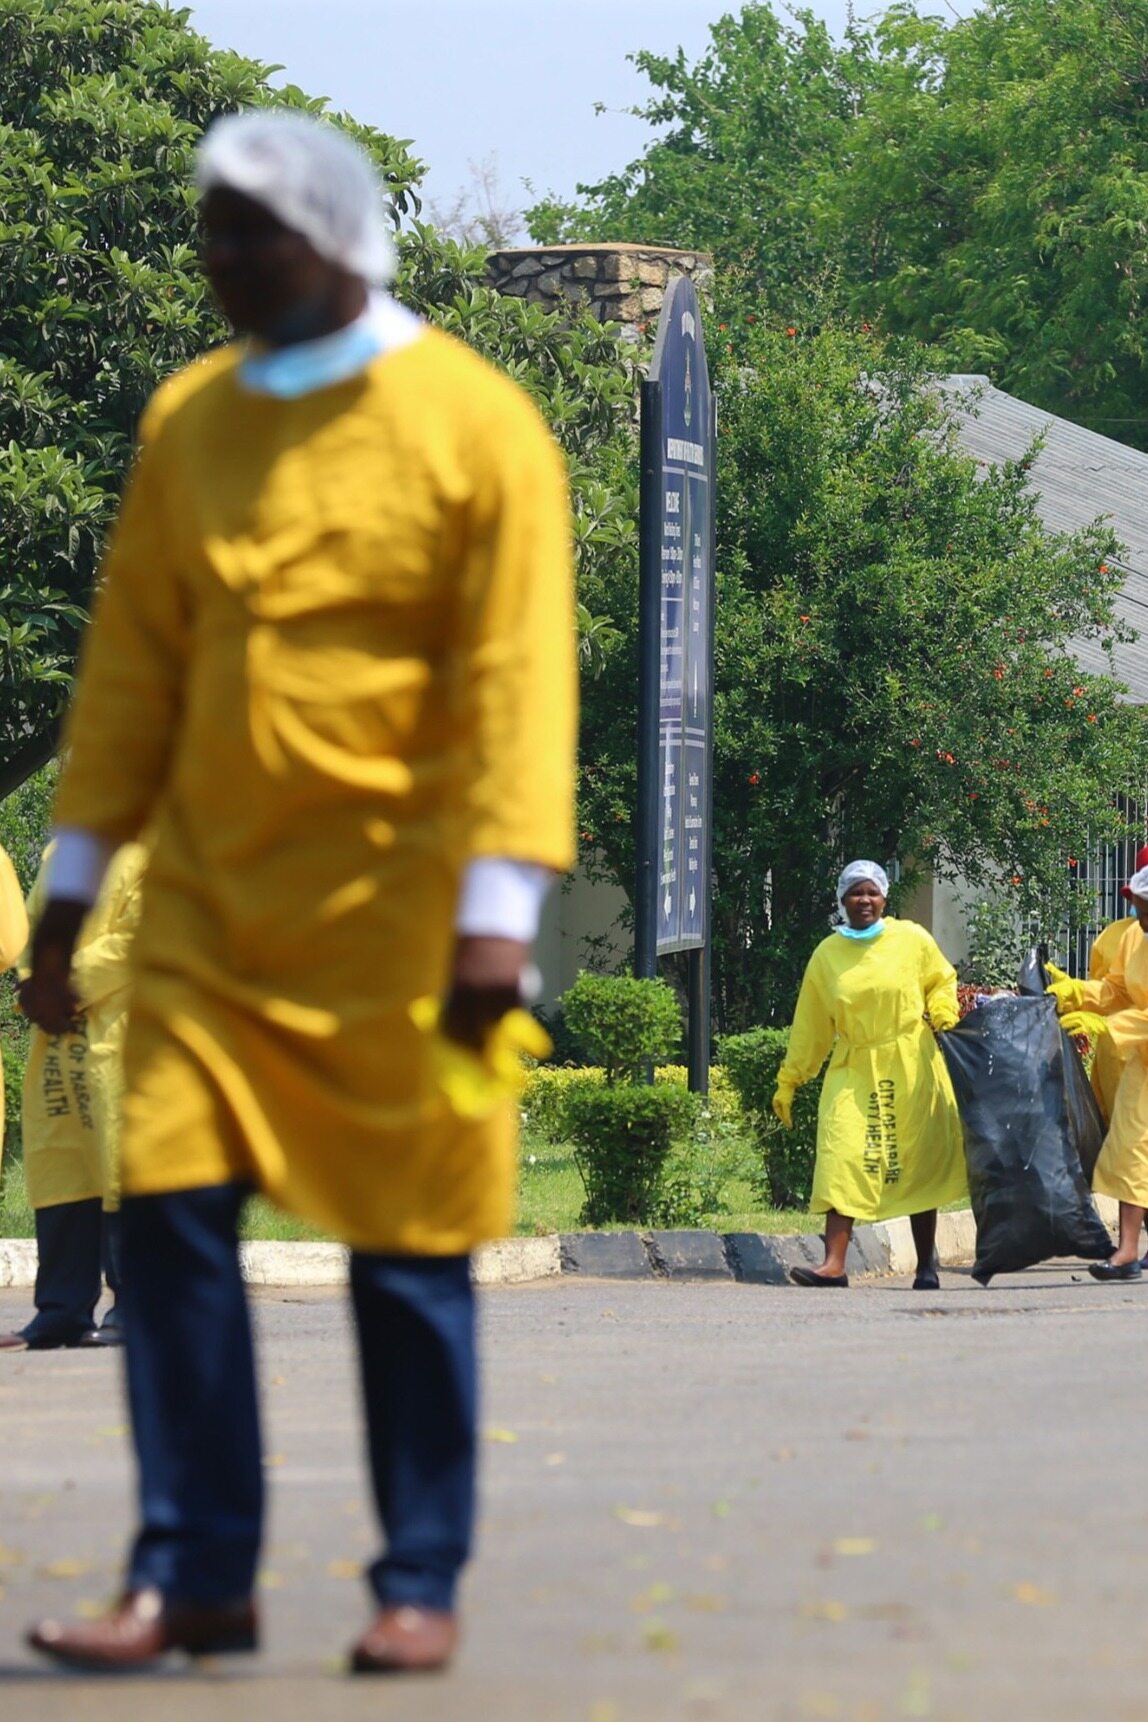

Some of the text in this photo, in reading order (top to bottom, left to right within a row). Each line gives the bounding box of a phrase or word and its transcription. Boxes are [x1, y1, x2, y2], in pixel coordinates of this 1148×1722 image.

[44, 1055, 70, 1118] HEALTH
[878, 1079, 895, 1109] CITY
[882, 1113, 896, 1129] OF
[864, 1124, 882, 1174] HEALTH
